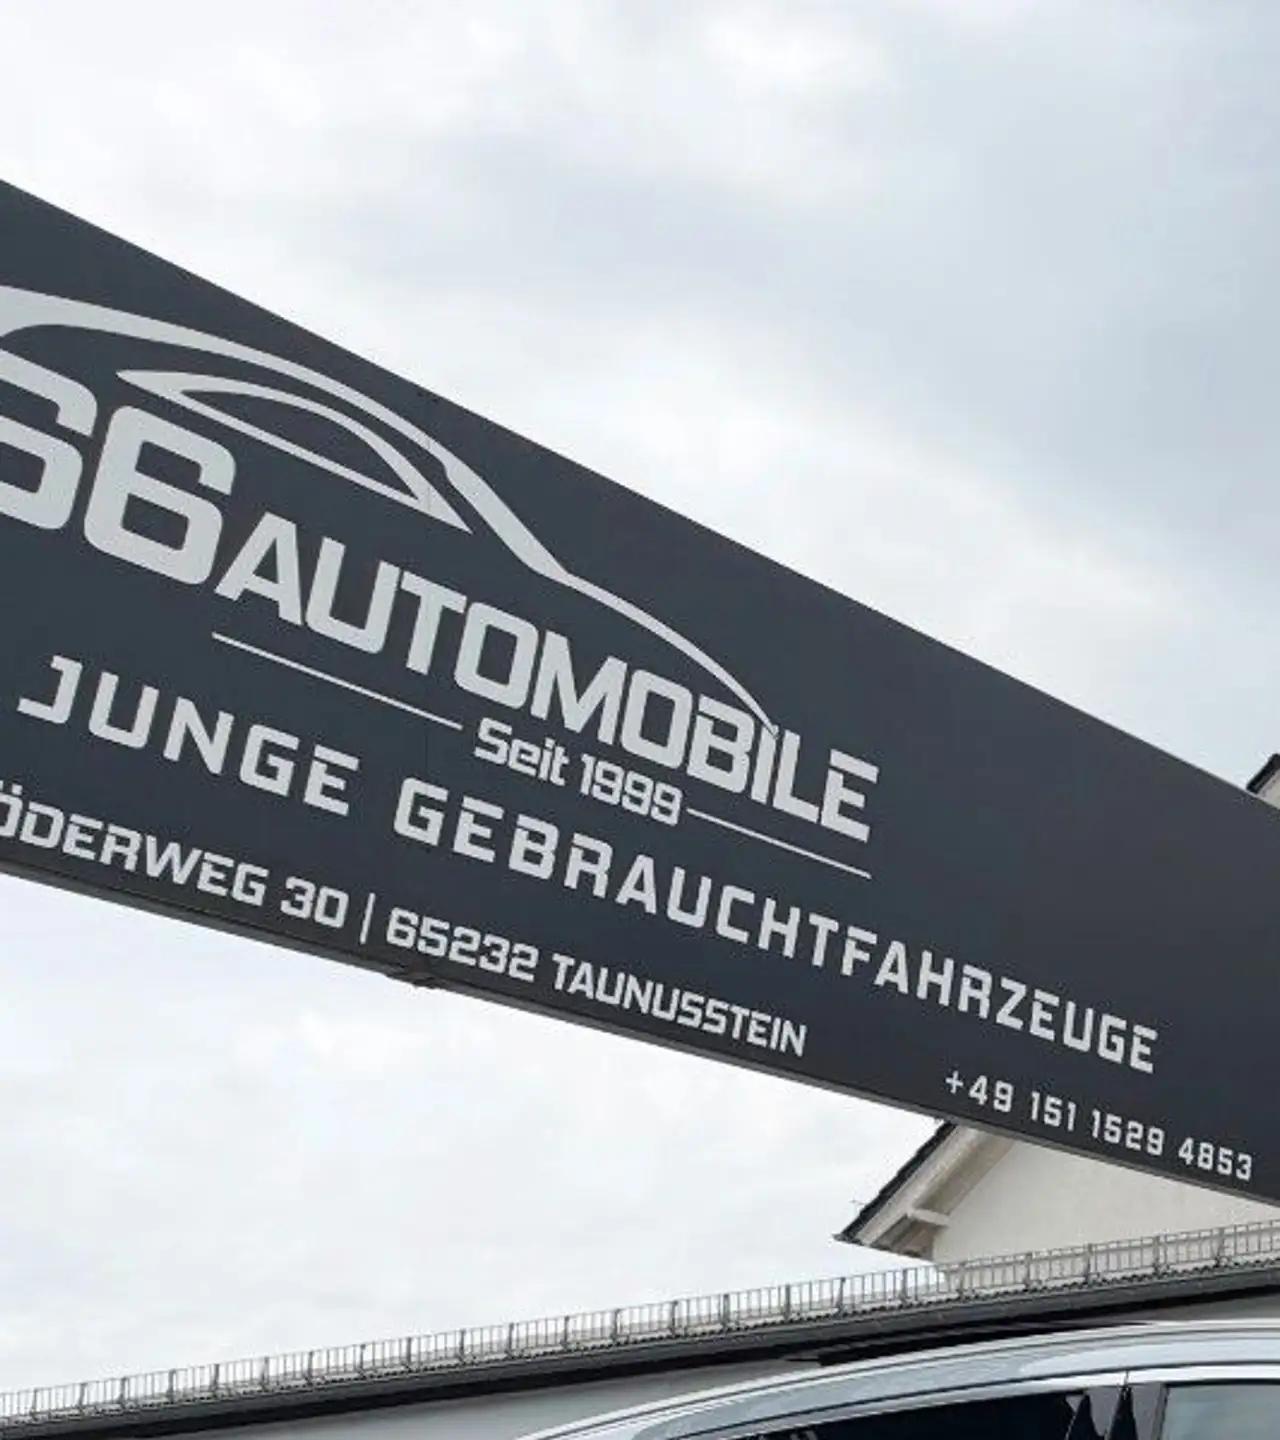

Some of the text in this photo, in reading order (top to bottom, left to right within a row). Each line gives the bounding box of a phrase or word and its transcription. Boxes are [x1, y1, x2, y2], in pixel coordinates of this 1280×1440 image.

[473, 717, 683, 826] Seit 1999
[16, 655, 1158, 1074] JUNGE GEBRAUCHTFAHRZEUGE
[280, 876, 349, 928] 30
[386, 907, 539, 982] 65232
[552, 952, 807, 1057] TAUNUSSTEIN
[945, 1071, 1252, 1181] +49 151 1529 4853
